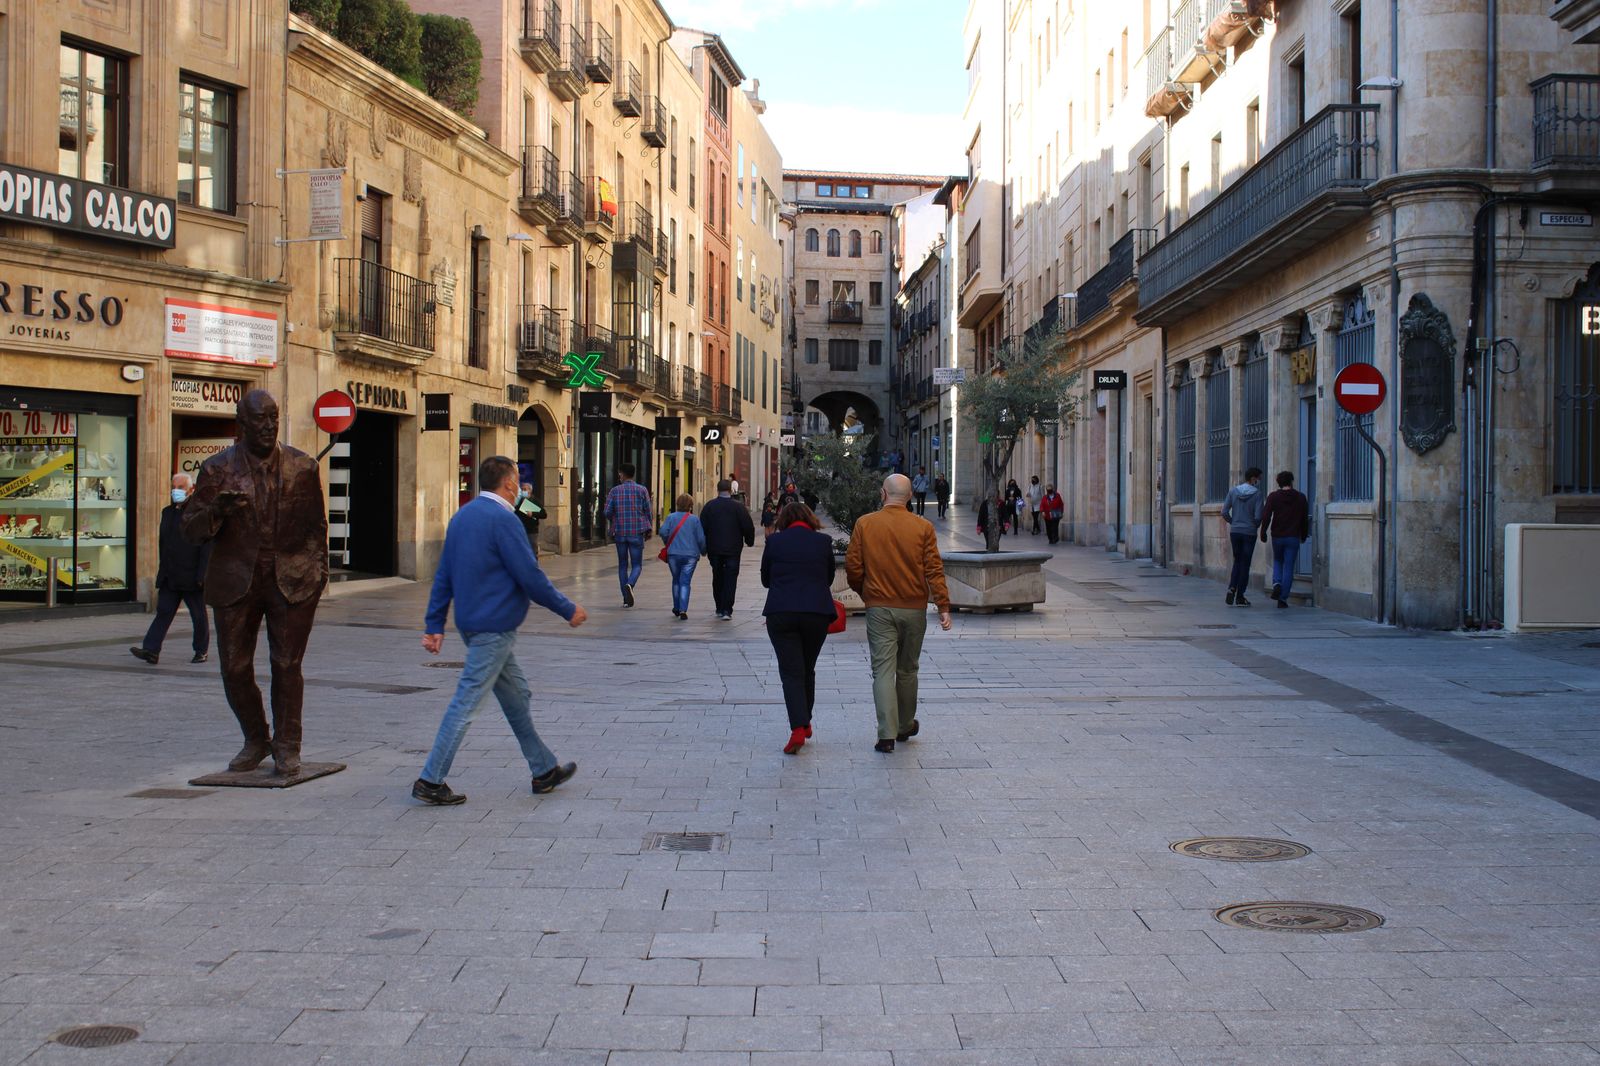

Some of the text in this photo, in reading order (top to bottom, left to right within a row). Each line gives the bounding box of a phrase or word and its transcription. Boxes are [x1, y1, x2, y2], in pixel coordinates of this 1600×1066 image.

[0, 170, 172, 241] OPIAS CALCO
[9, 324, 71, 341] JOYERÍAS
[1099, 376, 1120, 384] DRUNI
[202, 383, 240, 404] CALCO
[347, 381, 407, 410] SEPHORA
[704, 429, 720, 440] JD
